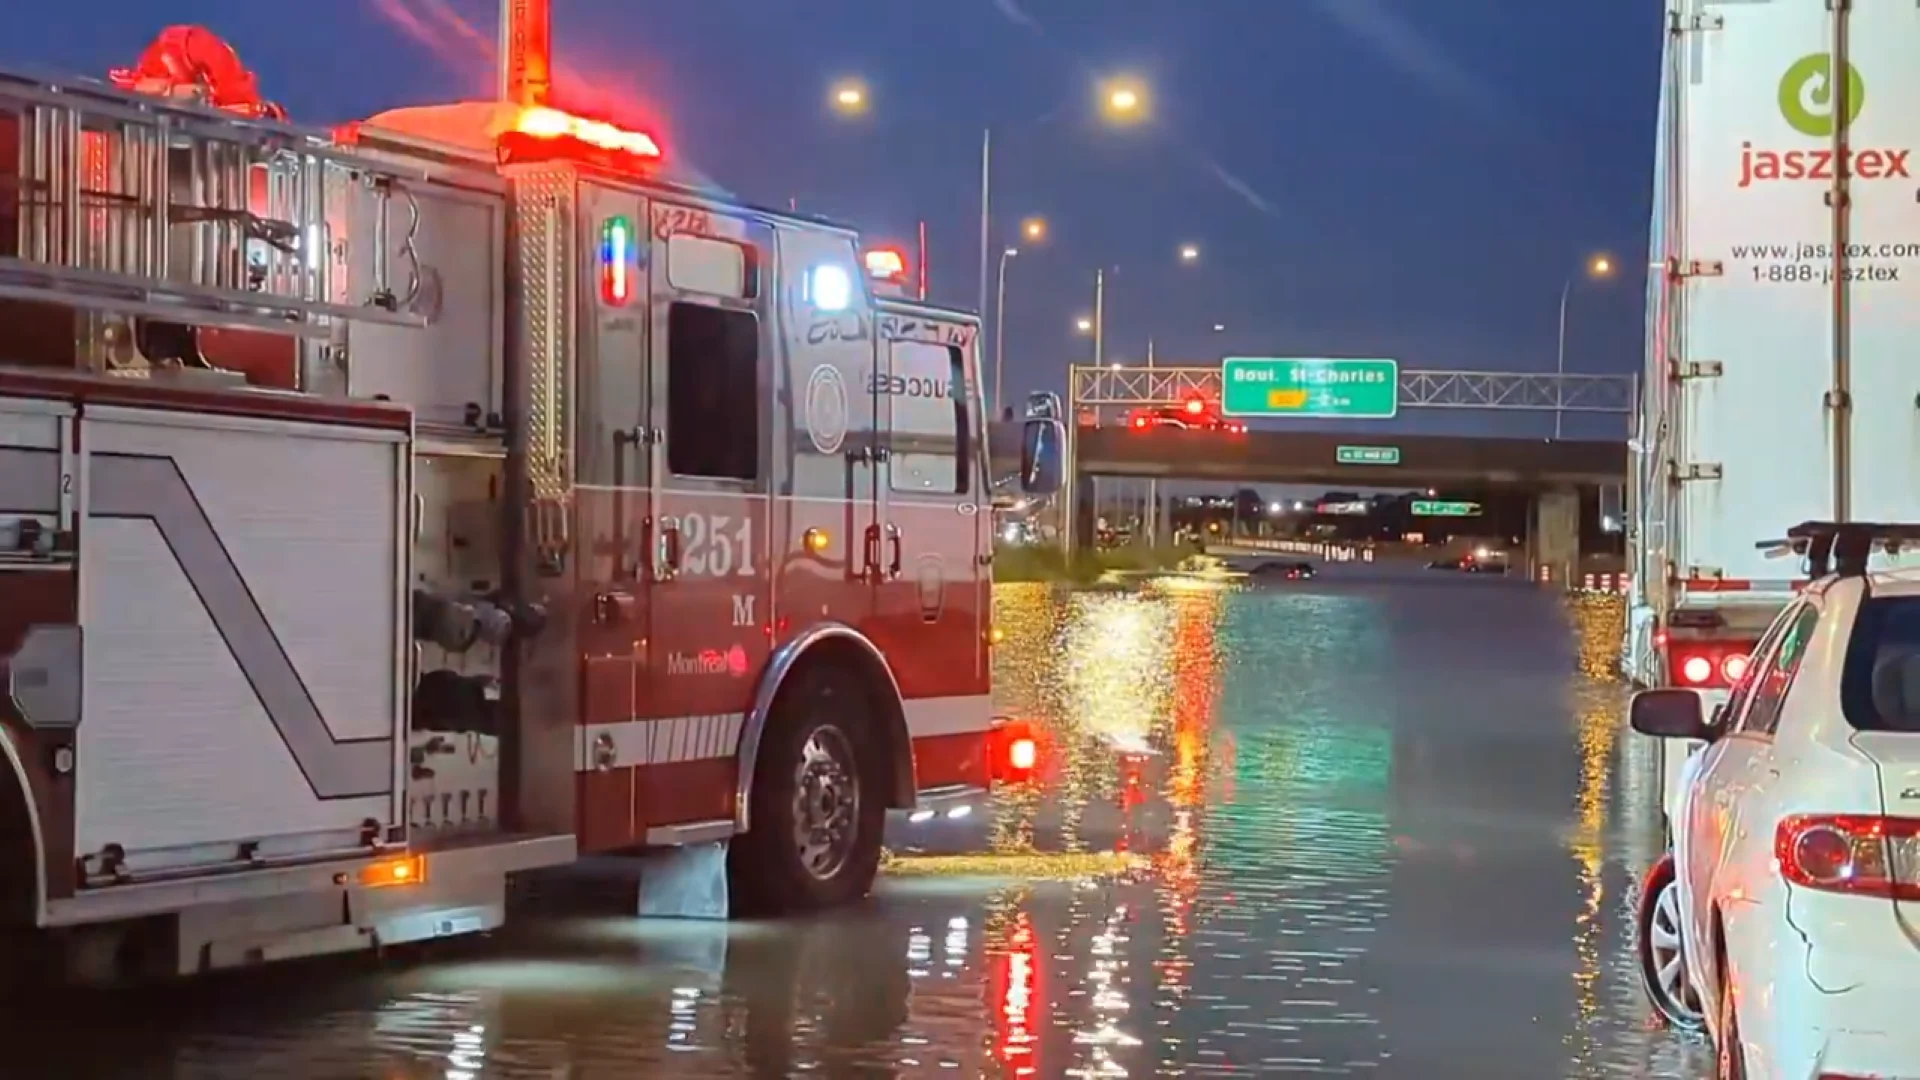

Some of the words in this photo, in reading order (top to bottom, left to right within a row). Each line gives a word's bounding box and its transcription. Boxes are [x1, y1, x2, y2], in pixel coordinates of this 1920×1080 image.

[1738, 141, 1910, 187] jasztex
[1732, 241, 1920, 262] www.jastex.com
[1234, 368, 1279, 383] Boul.
[1290, 368, 1385, 383] St-Charles
[63, 473, 72, 494] 2
[732, 594, 756, 626] M
